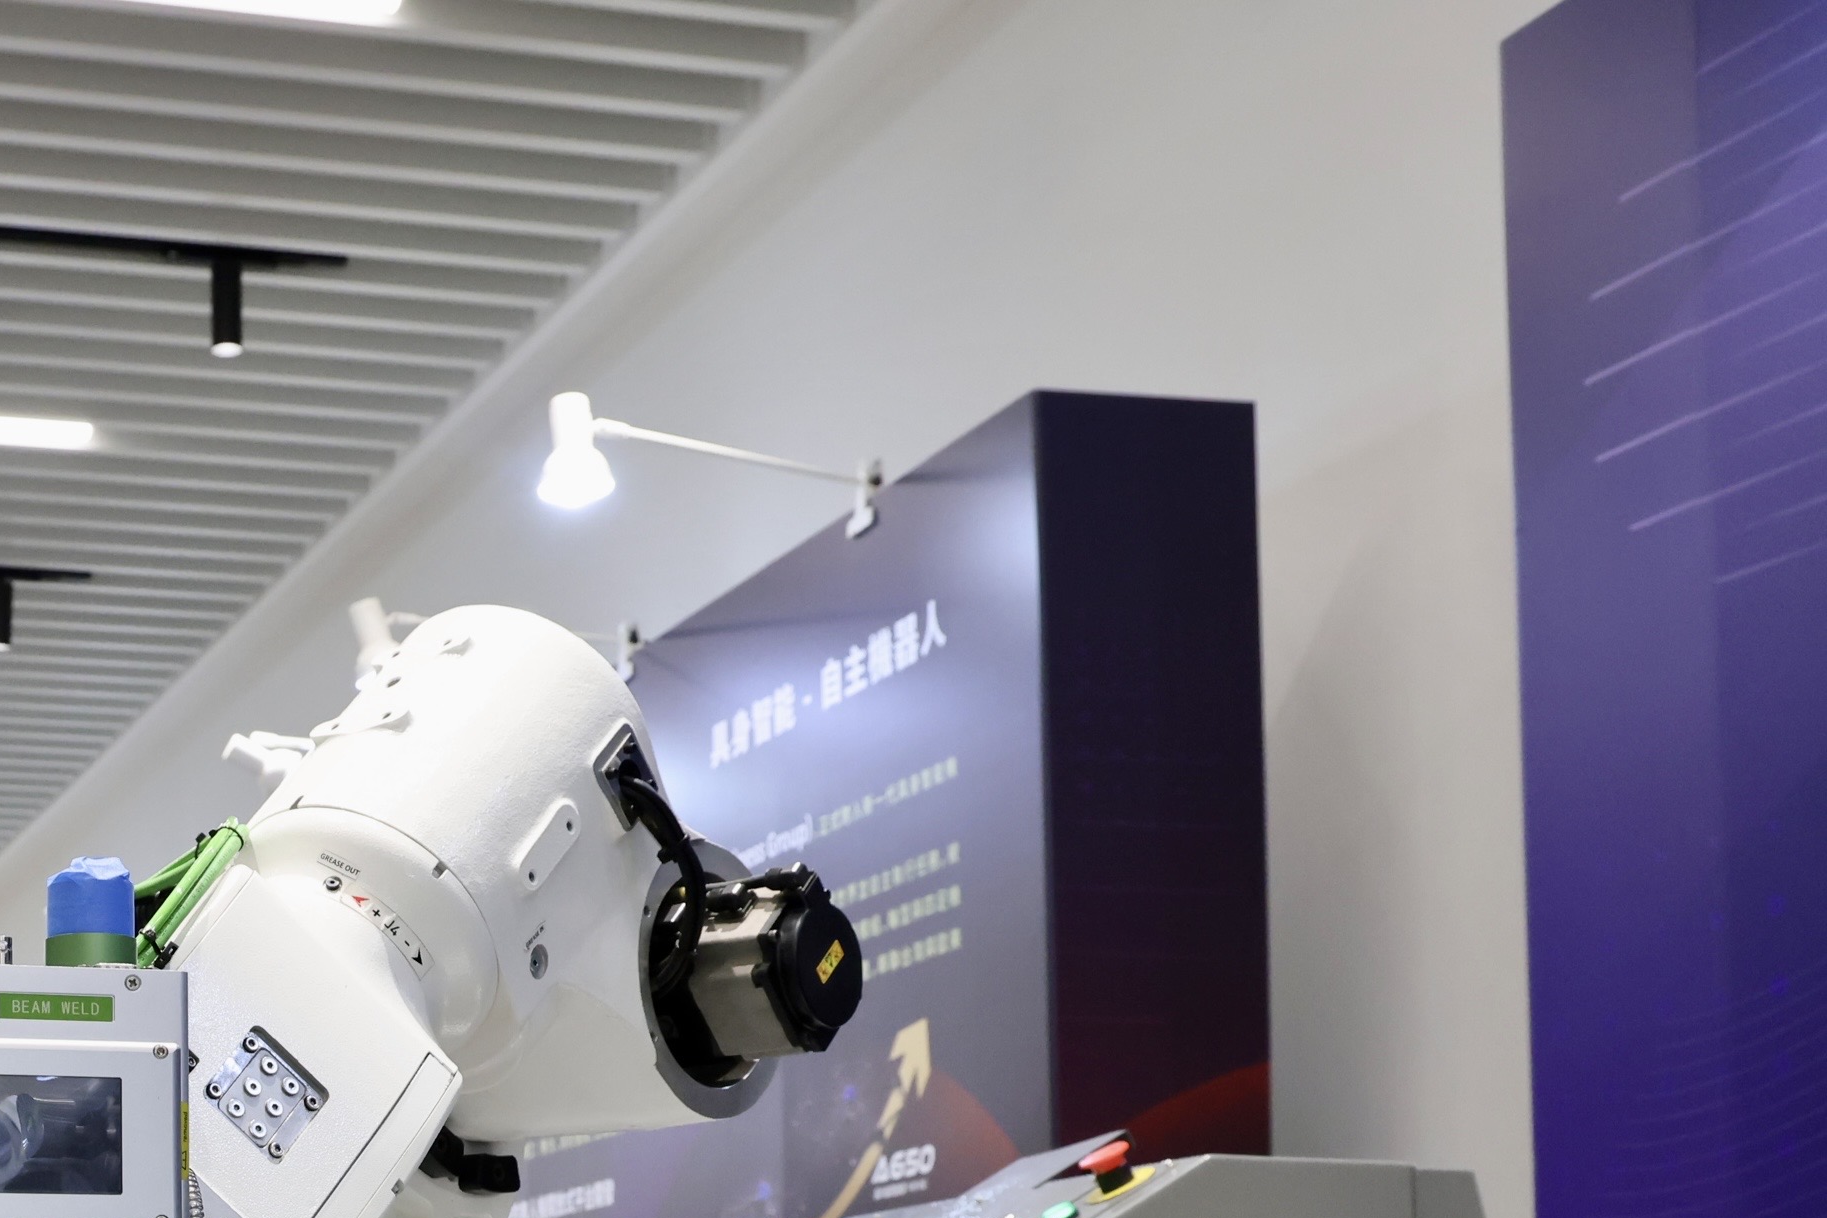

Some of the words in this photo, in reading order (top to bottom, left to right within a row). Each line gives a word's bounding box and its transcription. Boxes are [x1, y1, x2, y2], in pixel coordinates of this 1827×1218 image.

[320, 853, 345, 869] GREASE
[344, 864, 361, 876] OUT
[384, 920, 400, 936] J4
[12, 1000, 51, 1014] BEAM
[61, 1001, 100, 1016] WELD
